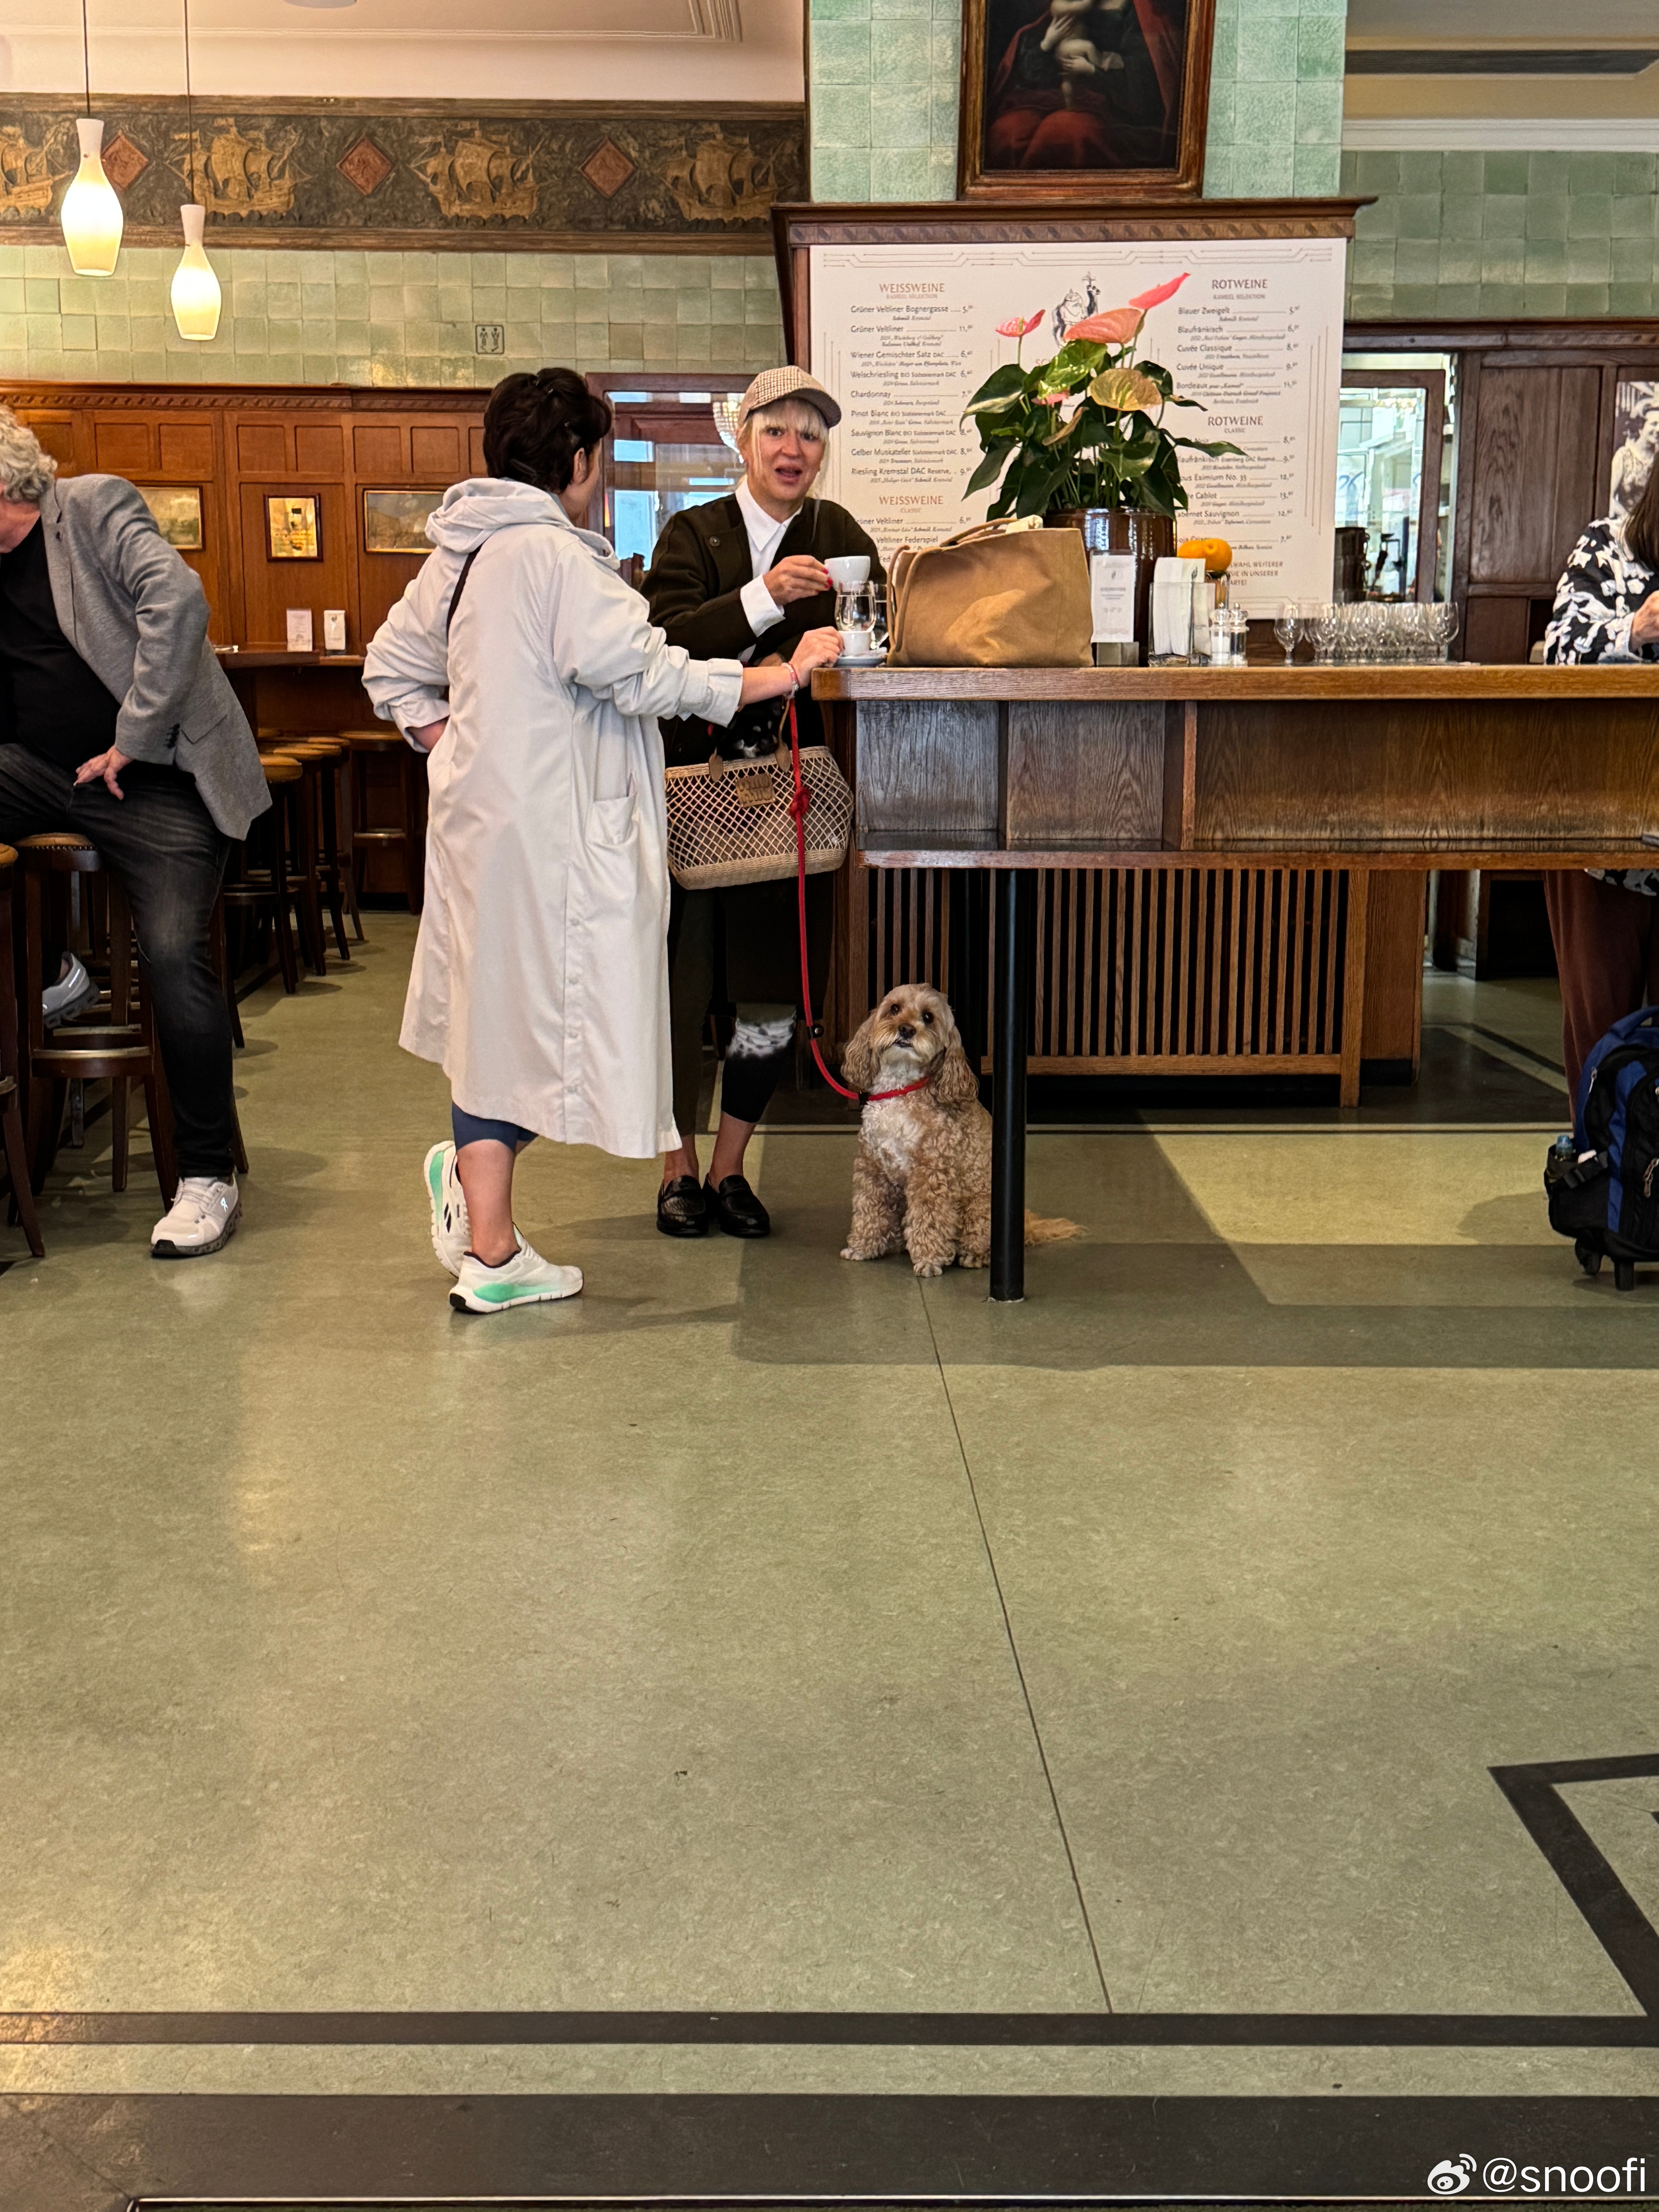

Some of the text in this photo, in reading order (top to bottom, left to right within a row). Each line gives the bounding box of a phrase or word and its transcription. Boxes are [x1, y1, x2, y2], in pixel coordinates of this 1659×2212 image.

[879, 283, 945, 293] WEISSWEINE
[1212, 279, 1267, 289] ROTWEINE
[906, 305, 949, 314] Bognergasse
[1200, 344, 1232, 352] Classique
[850, 371, 899, 379] Welschriesling
[1208, 416, 1263, 426] ROTWEINE
[851, 429, 884, 438] Sauvignon
[851, 468, 878, 477] Riesling
[879, 496, 944, 505] WEISSWEINE
[905, 536, 938, 544] Federspiel
